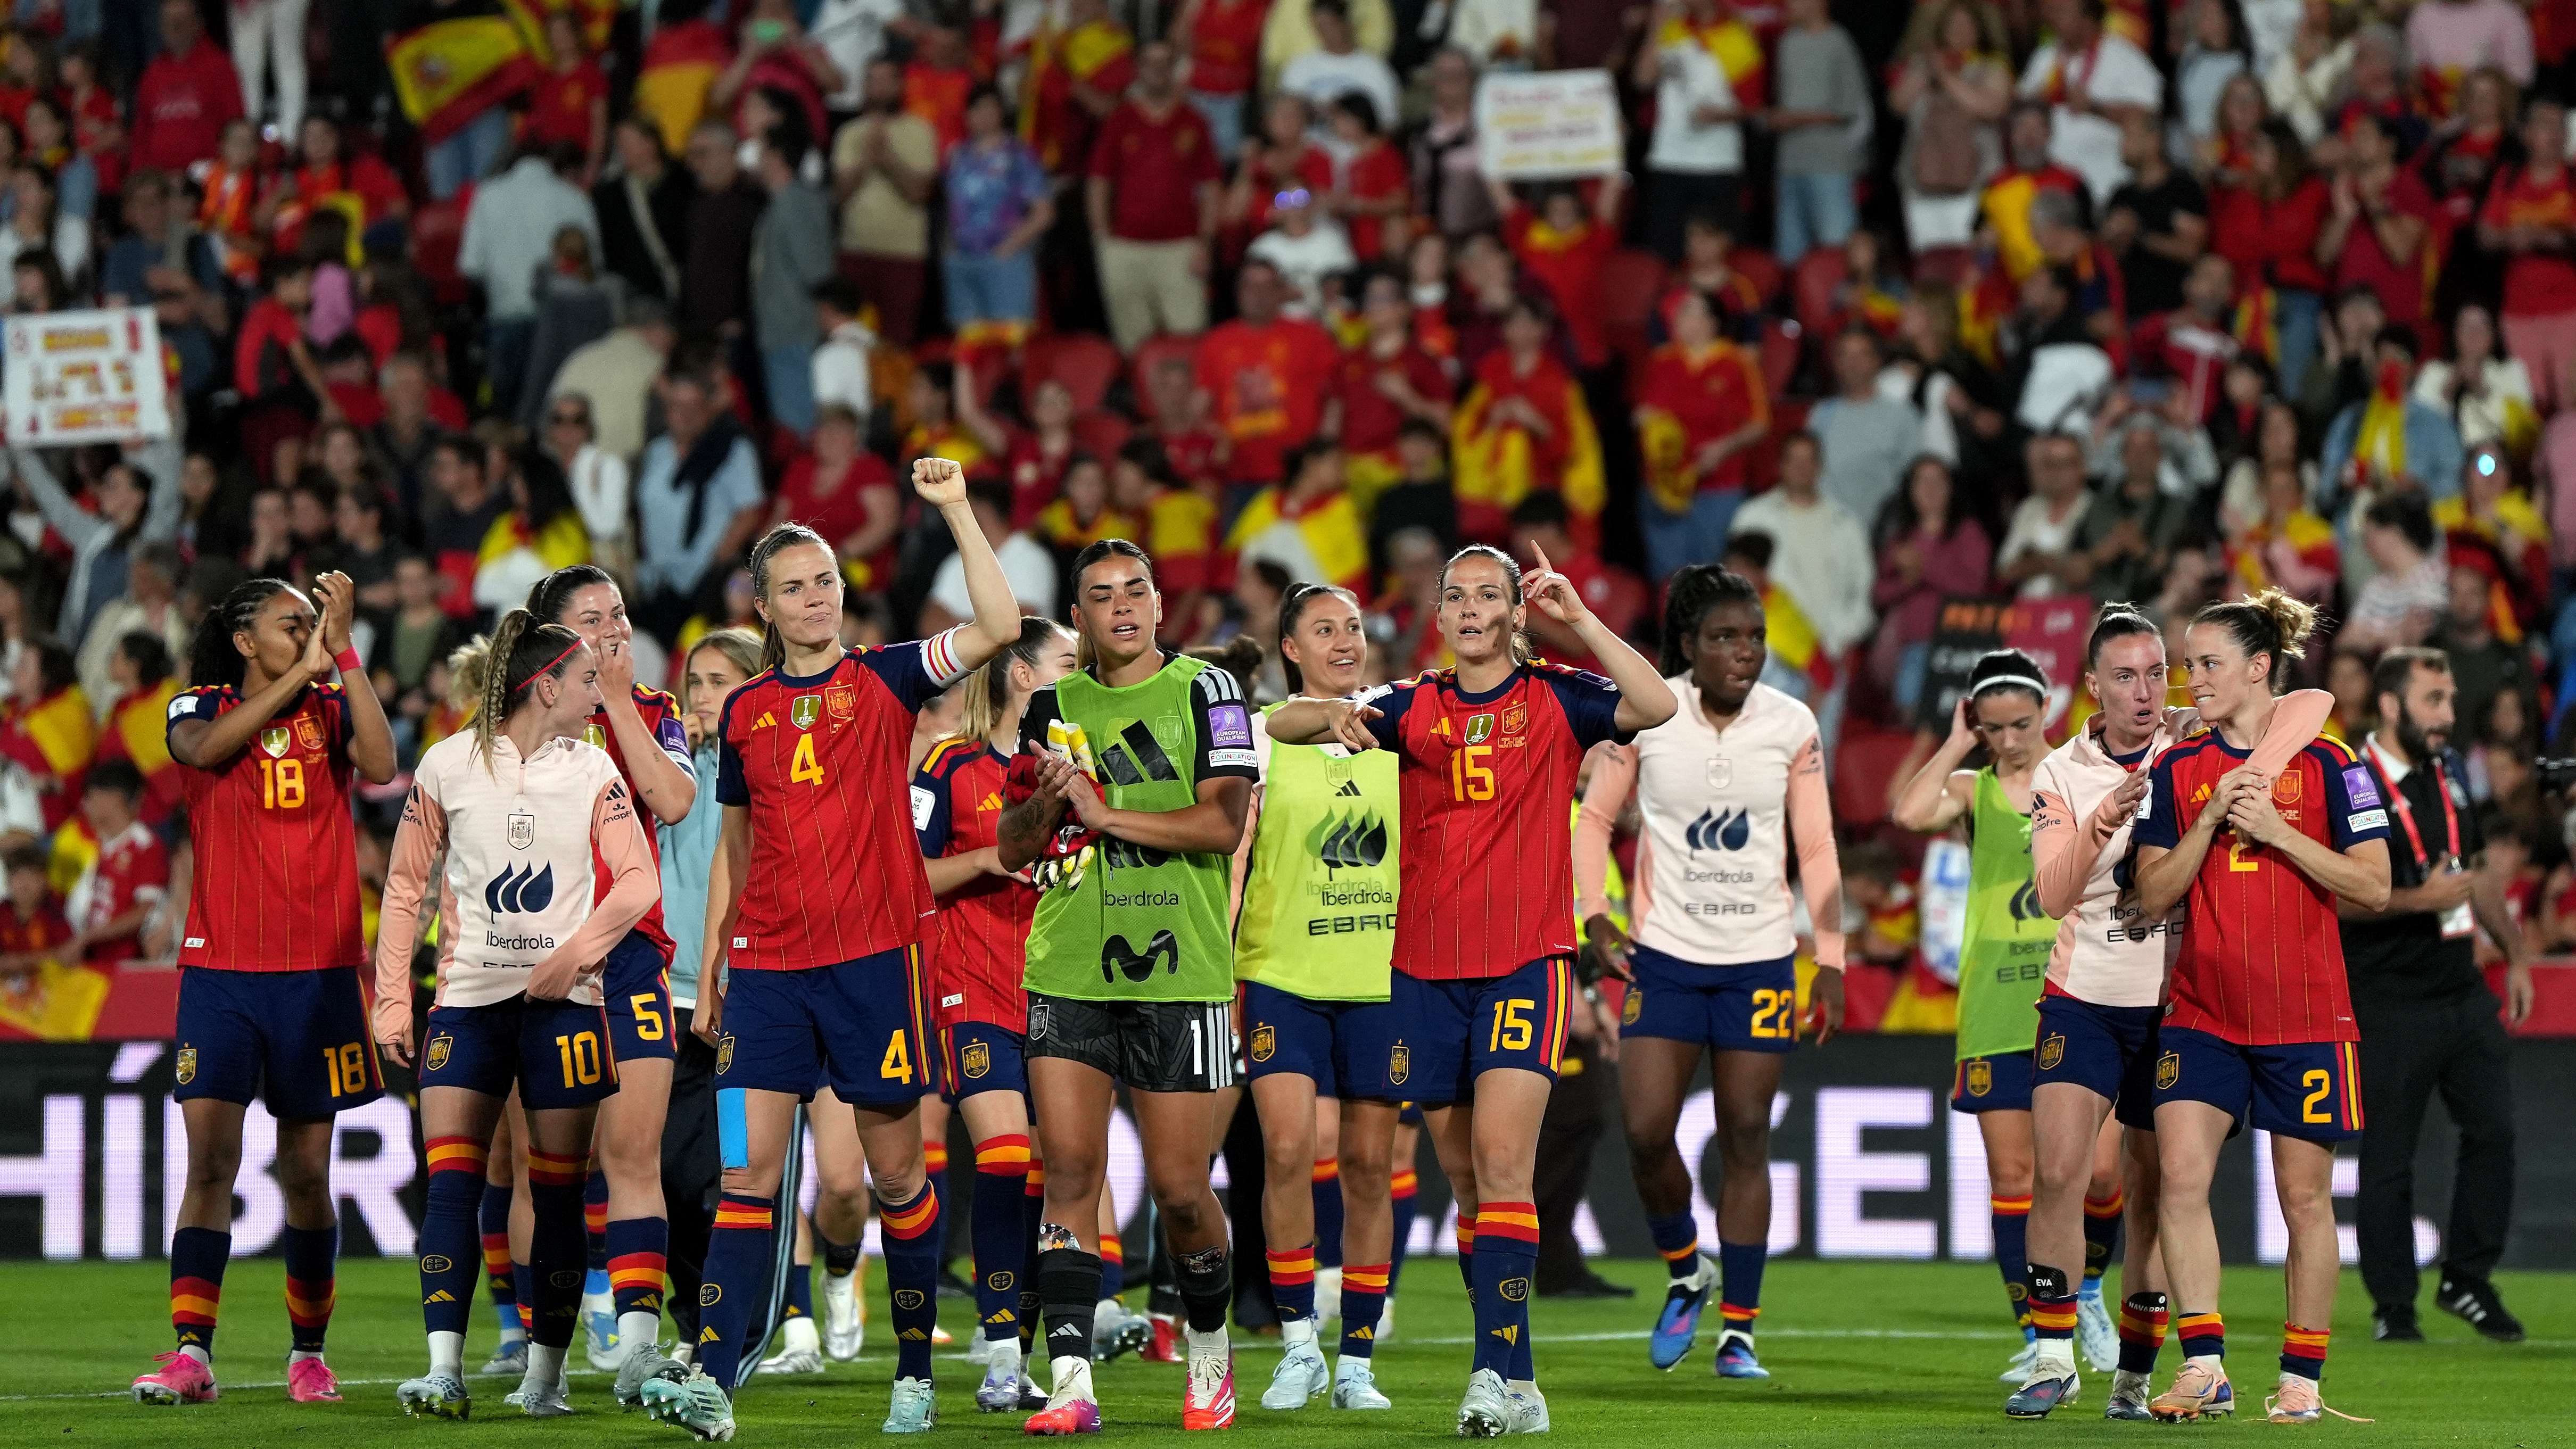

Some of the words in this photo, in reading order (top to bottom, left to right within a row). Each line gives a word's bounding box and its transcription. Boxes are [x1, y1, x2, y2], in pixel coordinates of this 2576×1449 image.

[260, 759, 306, 809] 18
[790, 733, 824, 785] 4
[1451, 746, 1495, 801] 15
[603, 809, 632, 825] mapfr
[1104, 889, 1179, 906] berdrola
[1322, 888, 1393, 906] Iberdrola
[1683, 866, 1755, 883] Iberdrola
[486, 930, 555, 950] Iberdrola
[630, 993, 664, 1041] 5
[1490, 998, 1535, 1052] 15
[1751, 988, 1794, 1039] 22
[324, 1041, 367, 1098] 18
[556, 1030, 600, 1088] 10
[880, 1029, 913, 1085] 4
[1190, 1020, 1202, 1075] 1
[2302, 1069, 2332, 1123] 2
